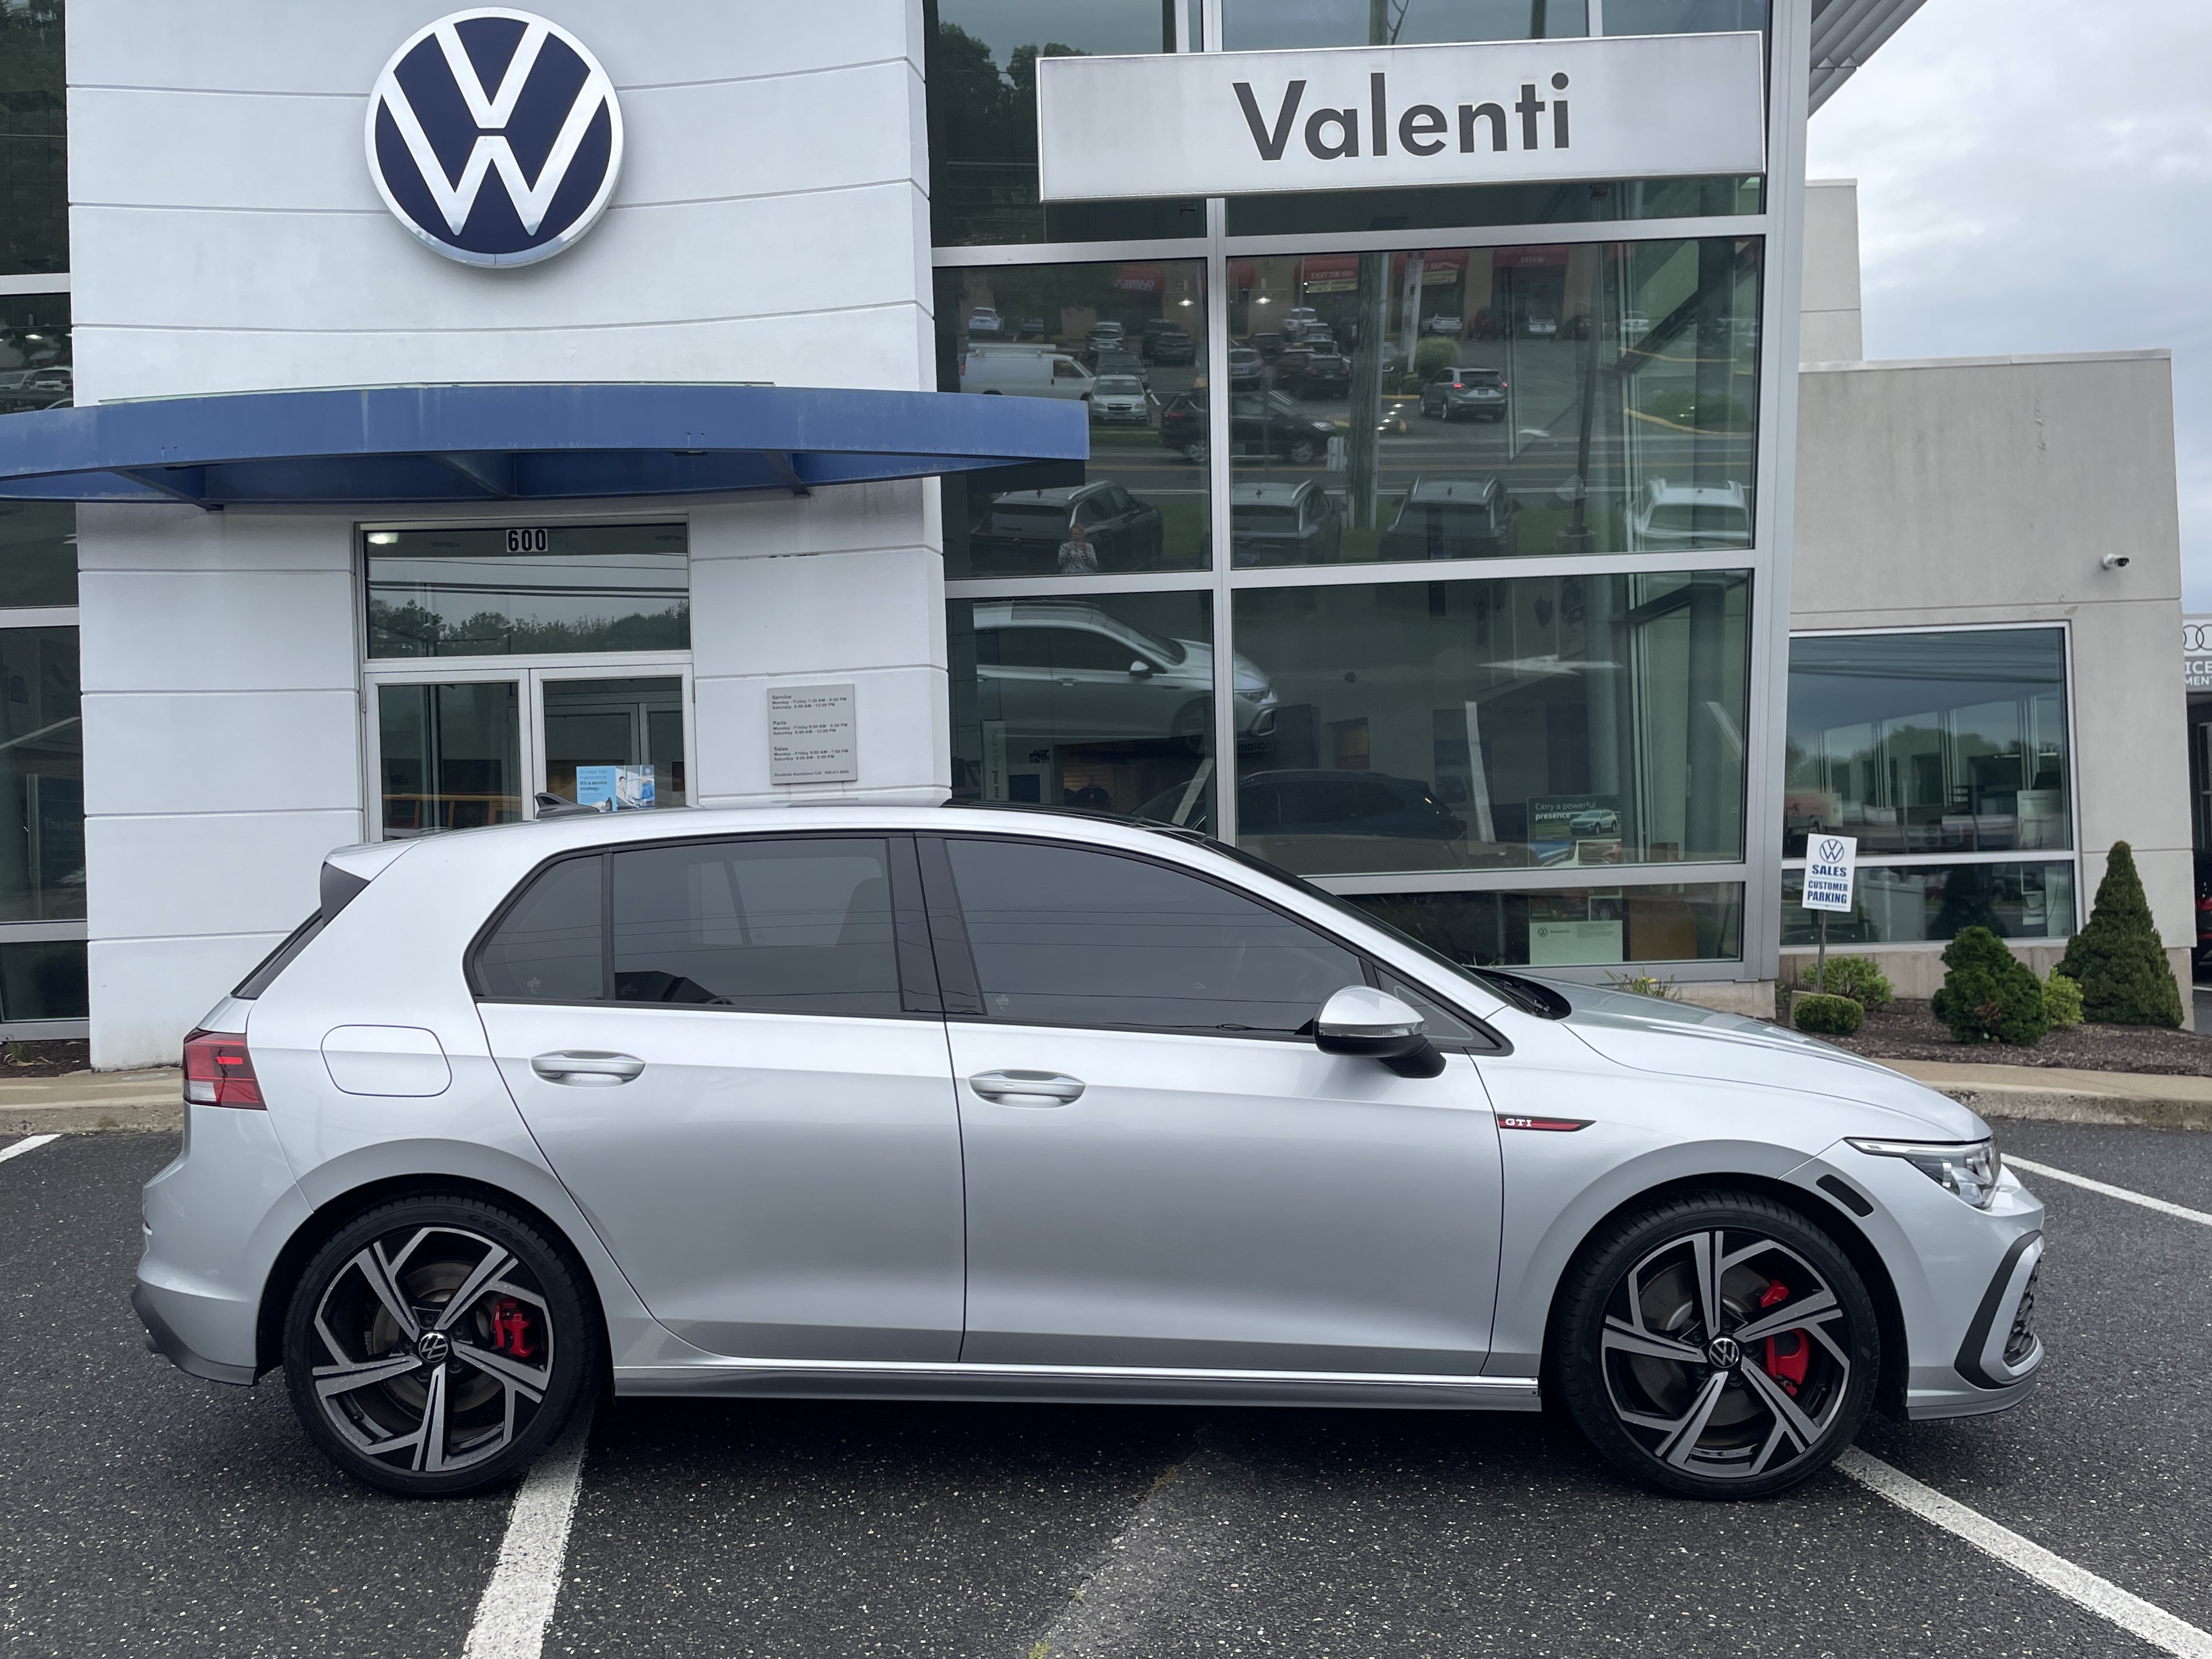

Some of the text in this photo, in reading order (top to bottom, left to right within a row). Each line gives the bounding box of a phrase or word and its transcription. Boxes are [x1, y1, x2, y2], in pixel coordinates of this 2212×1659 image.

[1232, 71, 1570, 161] Valenti
[508, 529, 546, 552] 600
[2185, 660, 2212, 674] ICE
[1535, 803, 1555, 811] Carry
[1563, 802, 1596, 811] powerful
[1535, 813, 1570, 821] presence
[1812, 864, 1847, 877] SALES
[1809, 880, 1848, 892] CUSTOMER
[1807, 891, 1846, 904] PARKING
[1505, 1118, 1532, 1127] GTI
